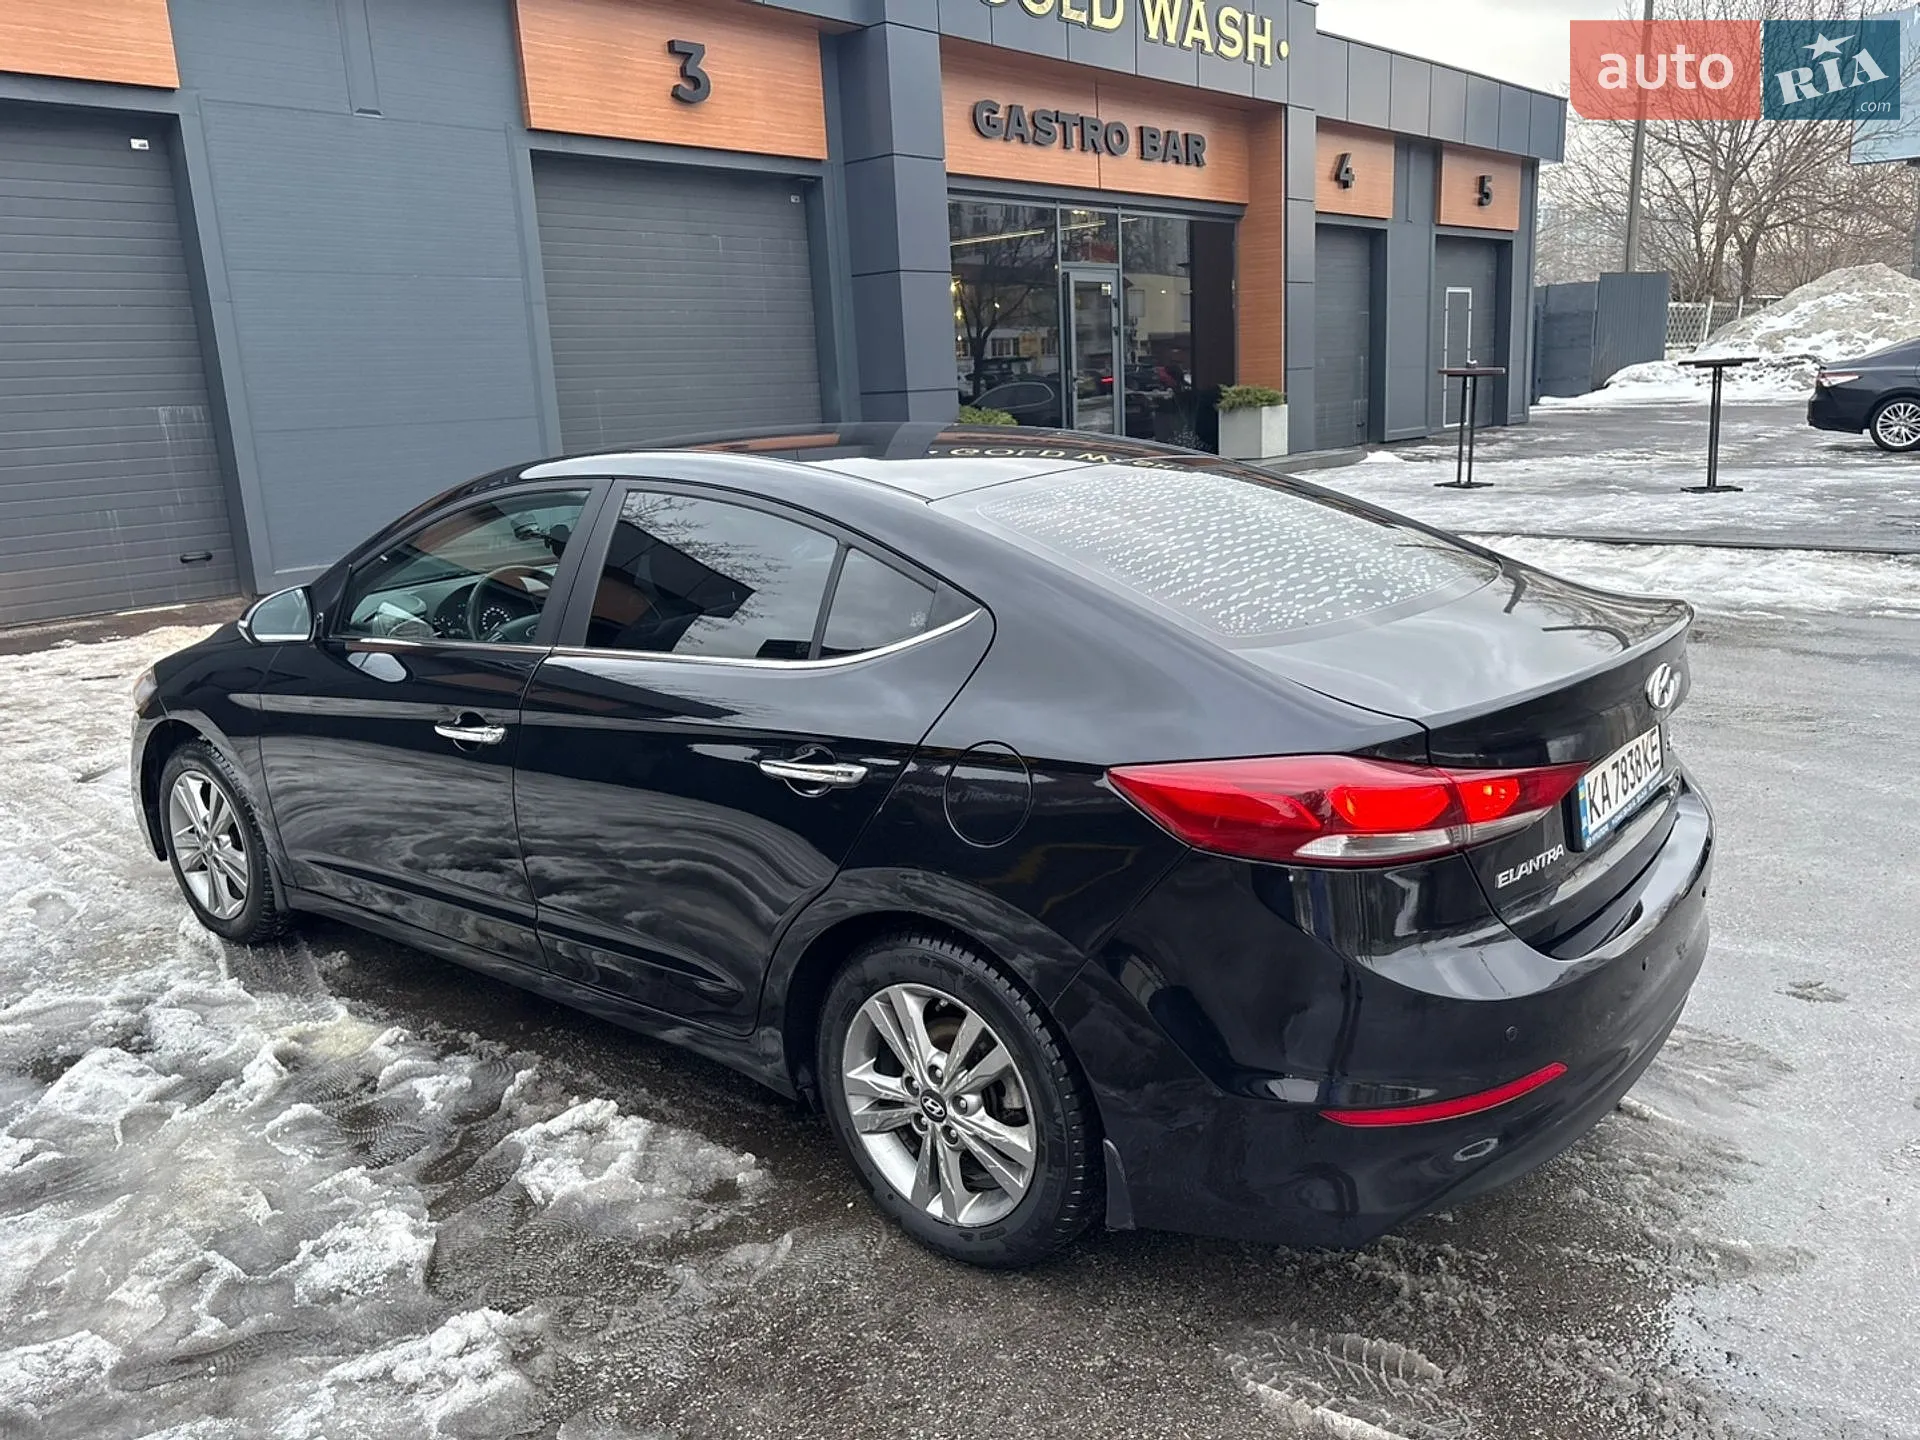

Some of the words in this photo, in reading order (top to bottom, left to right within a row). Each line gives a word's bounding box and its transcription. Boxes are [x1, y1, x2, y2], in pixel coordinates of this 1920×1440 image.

[1138, 0, 1273, 68] WASH
[667, 39, 711, 104] 3
[973, 99, 1130, 157] GASTRO
[1139, 125, 1207, 167] BAR
[1333, 152, 1356, 190] 4
[1477, 174, 1493, 207] 5
[1495, 843, 1565, 889] ELANTRA
